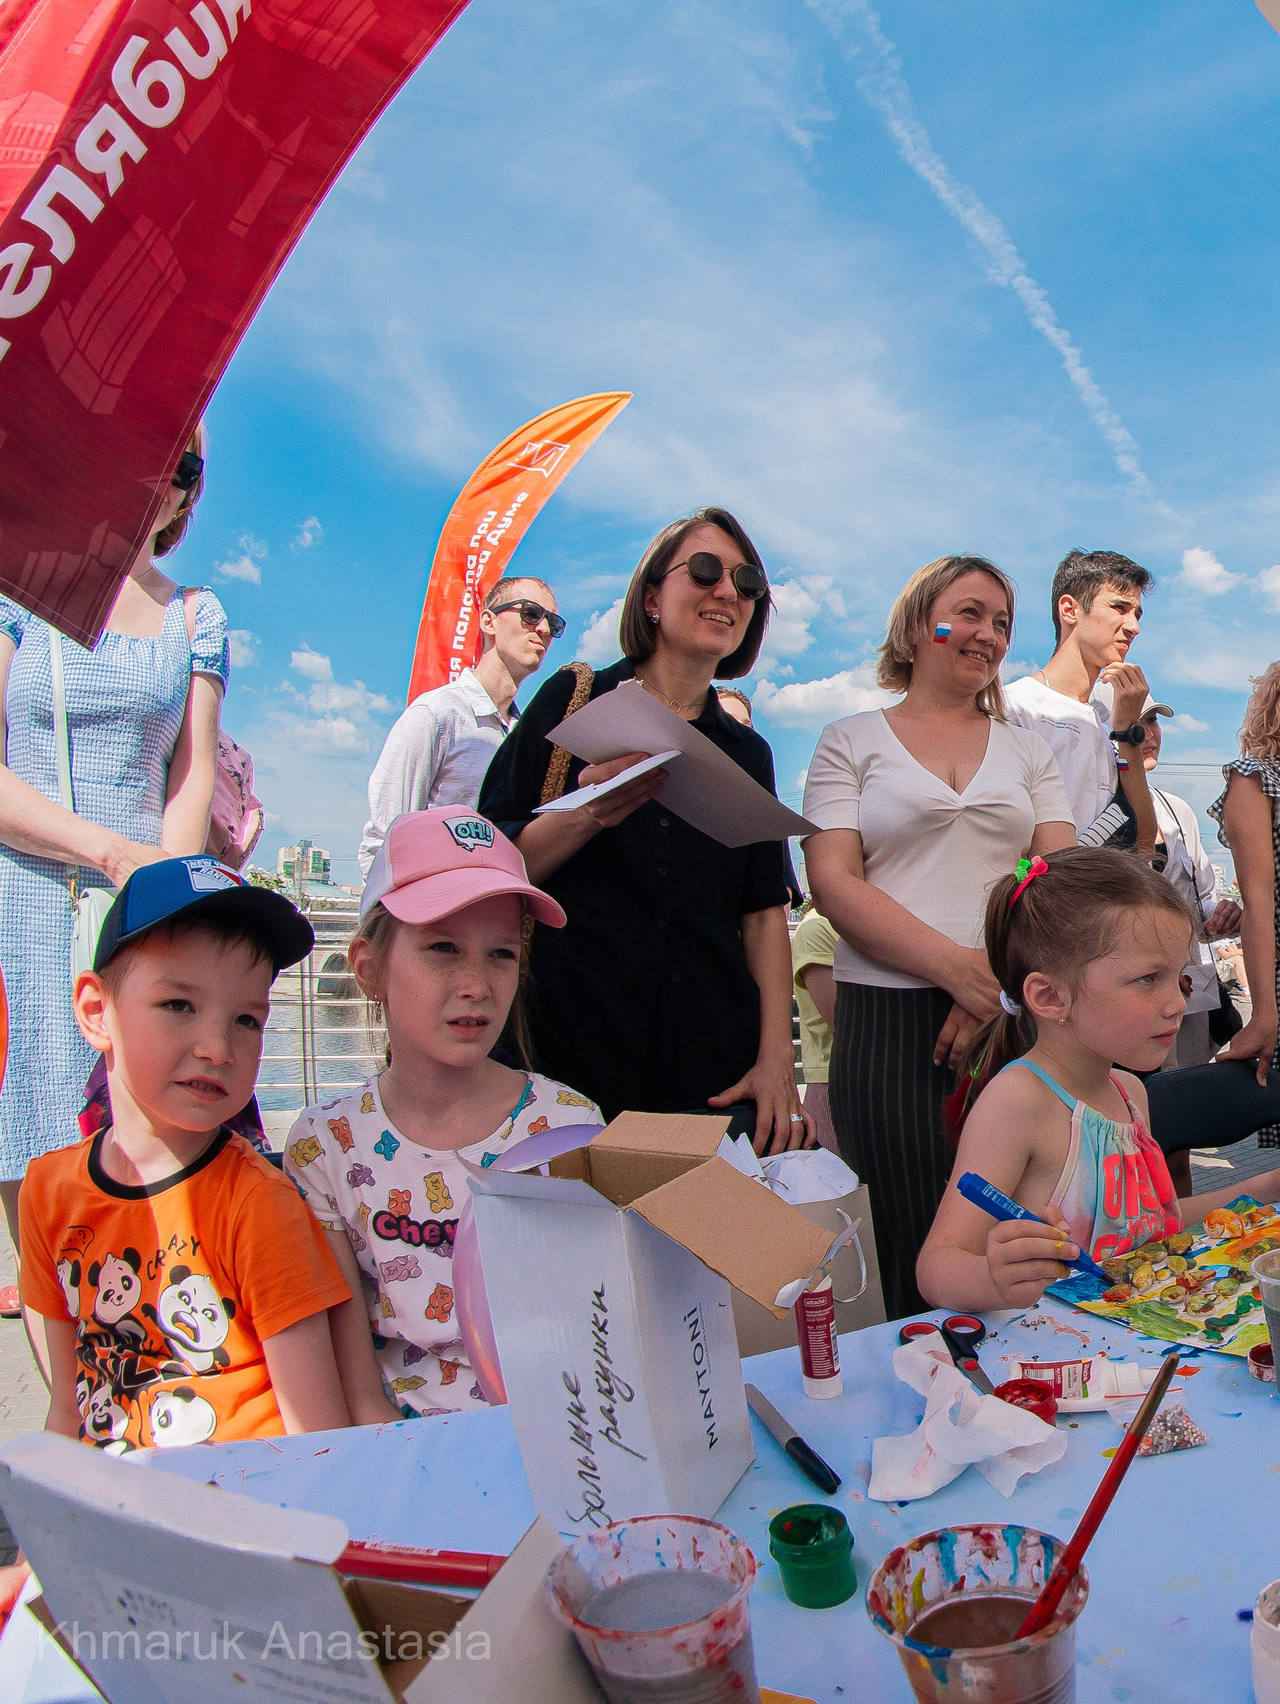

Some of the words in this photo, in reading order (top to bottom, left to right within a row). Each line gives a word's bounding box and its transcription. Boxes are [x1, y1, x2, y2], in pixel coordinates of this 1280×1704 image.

[0, 0, 252, 362] еляби
[469, 510, 498, 548] при
[486, 491, 529, 546] Думе
[454, 821, 492, 842] OH!
[146, 1233, 200, 1281] CRAZY
